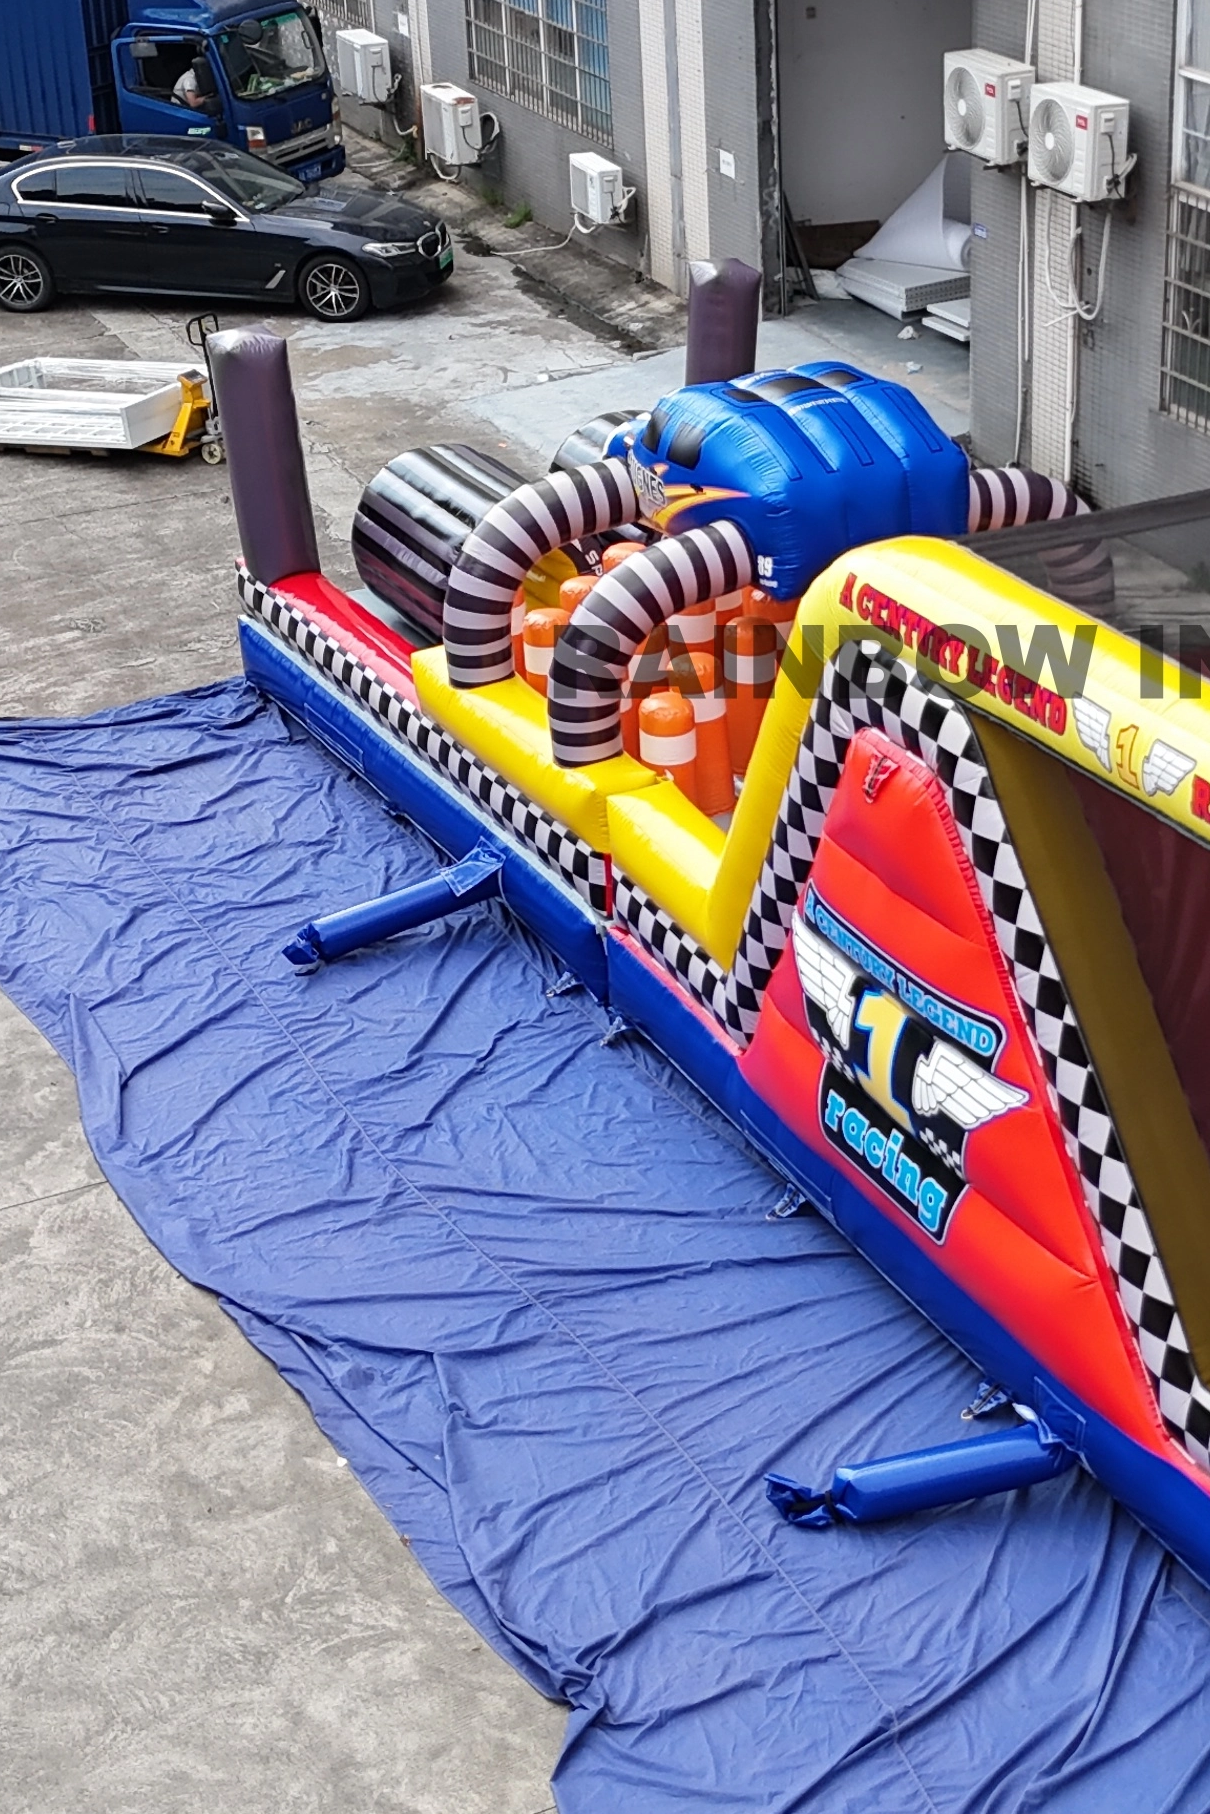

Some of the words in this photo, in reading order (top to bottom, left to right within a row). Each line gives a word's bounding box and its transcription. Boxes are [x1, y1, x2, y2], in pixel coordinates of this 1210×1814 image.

[839, 571, 857, 612] A
[856, 583, 967, 678] CENTURY
[967, 643, 1068, 736] LEGEND
[806, 887, 815, 923] A
[815, 904, 897, 993] CENTURY
[896, 972, 997, 1058] LEGEND
[853, 986, 917, 1138] 1
[824, 1089, 948, 1232] racing
